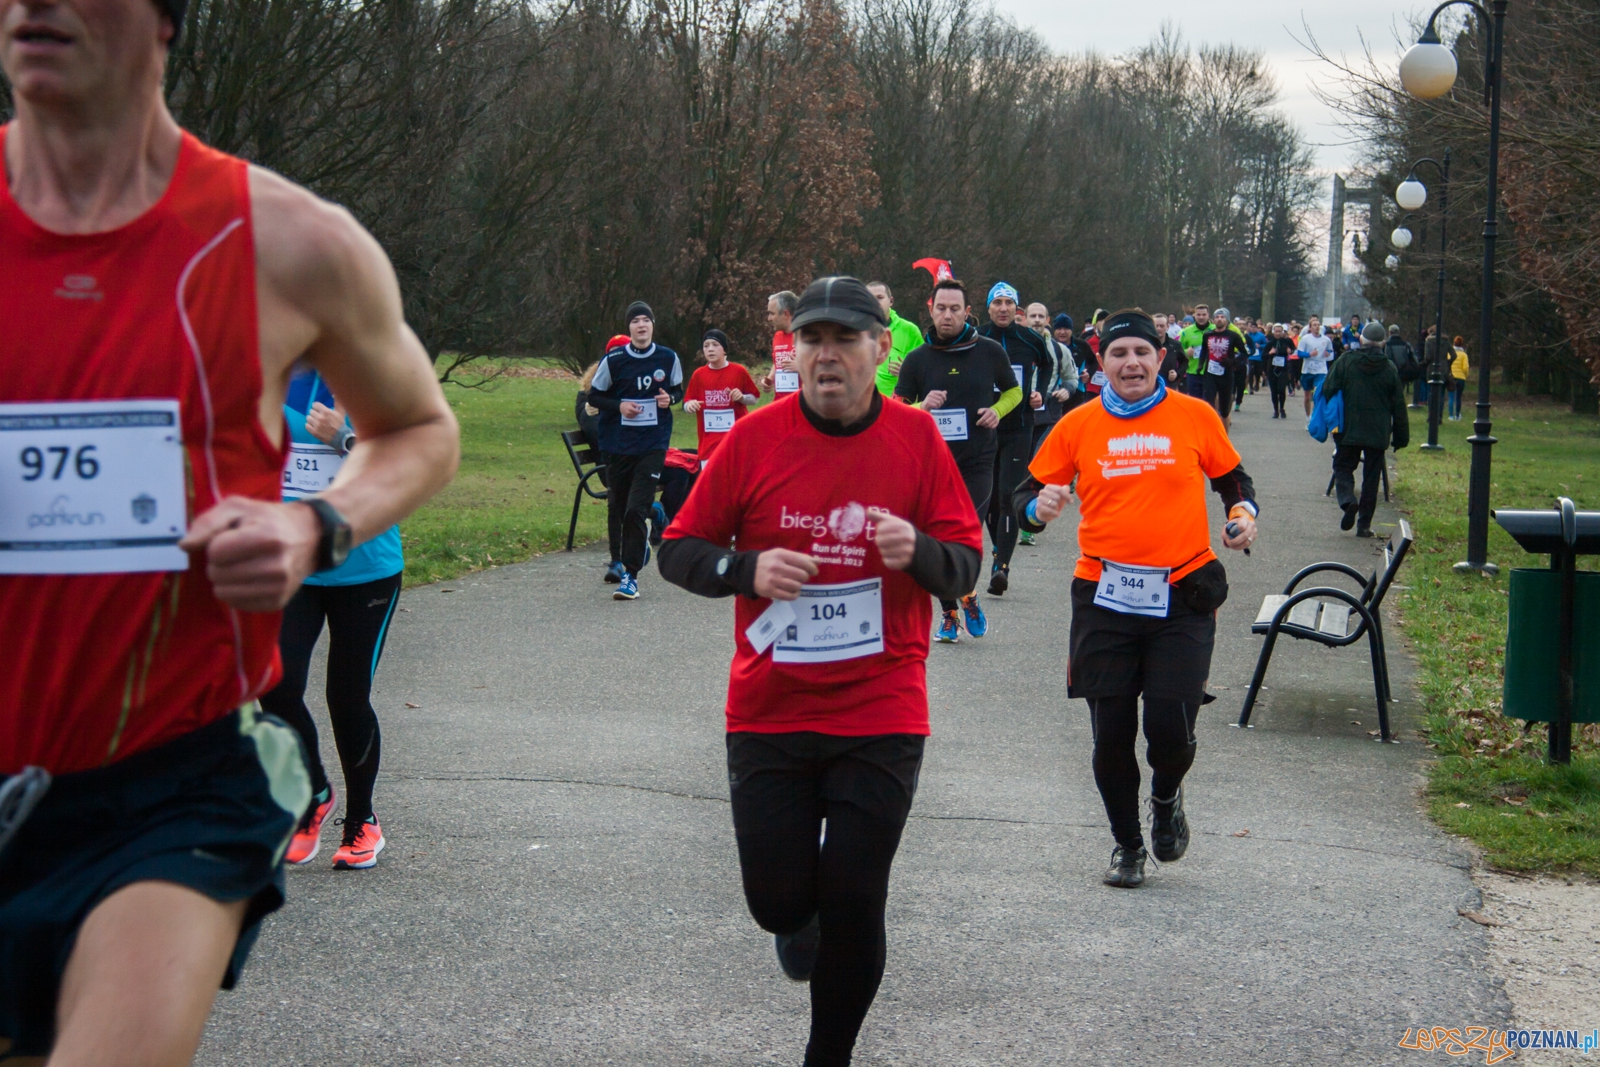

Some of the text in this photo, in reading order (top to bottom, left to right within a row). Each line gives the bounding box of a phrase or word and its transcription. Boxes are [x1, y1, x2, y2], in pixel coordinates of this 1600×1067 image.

[637, 376, 652, 391] 19
[938, 417, 952, 425] 185
[20, 445, 100, 482] 976
[296, 458, 319, 471] 621
[780, 505, 827, 538] bieg
[812, 543, 866, 557] Run of Spirit
[843, 557, 863, 567] 2013
[1120, 576, 1145, 590] 944
[810, 603, 848, 621] 104
[813, 629, 849, 643] parkrun
